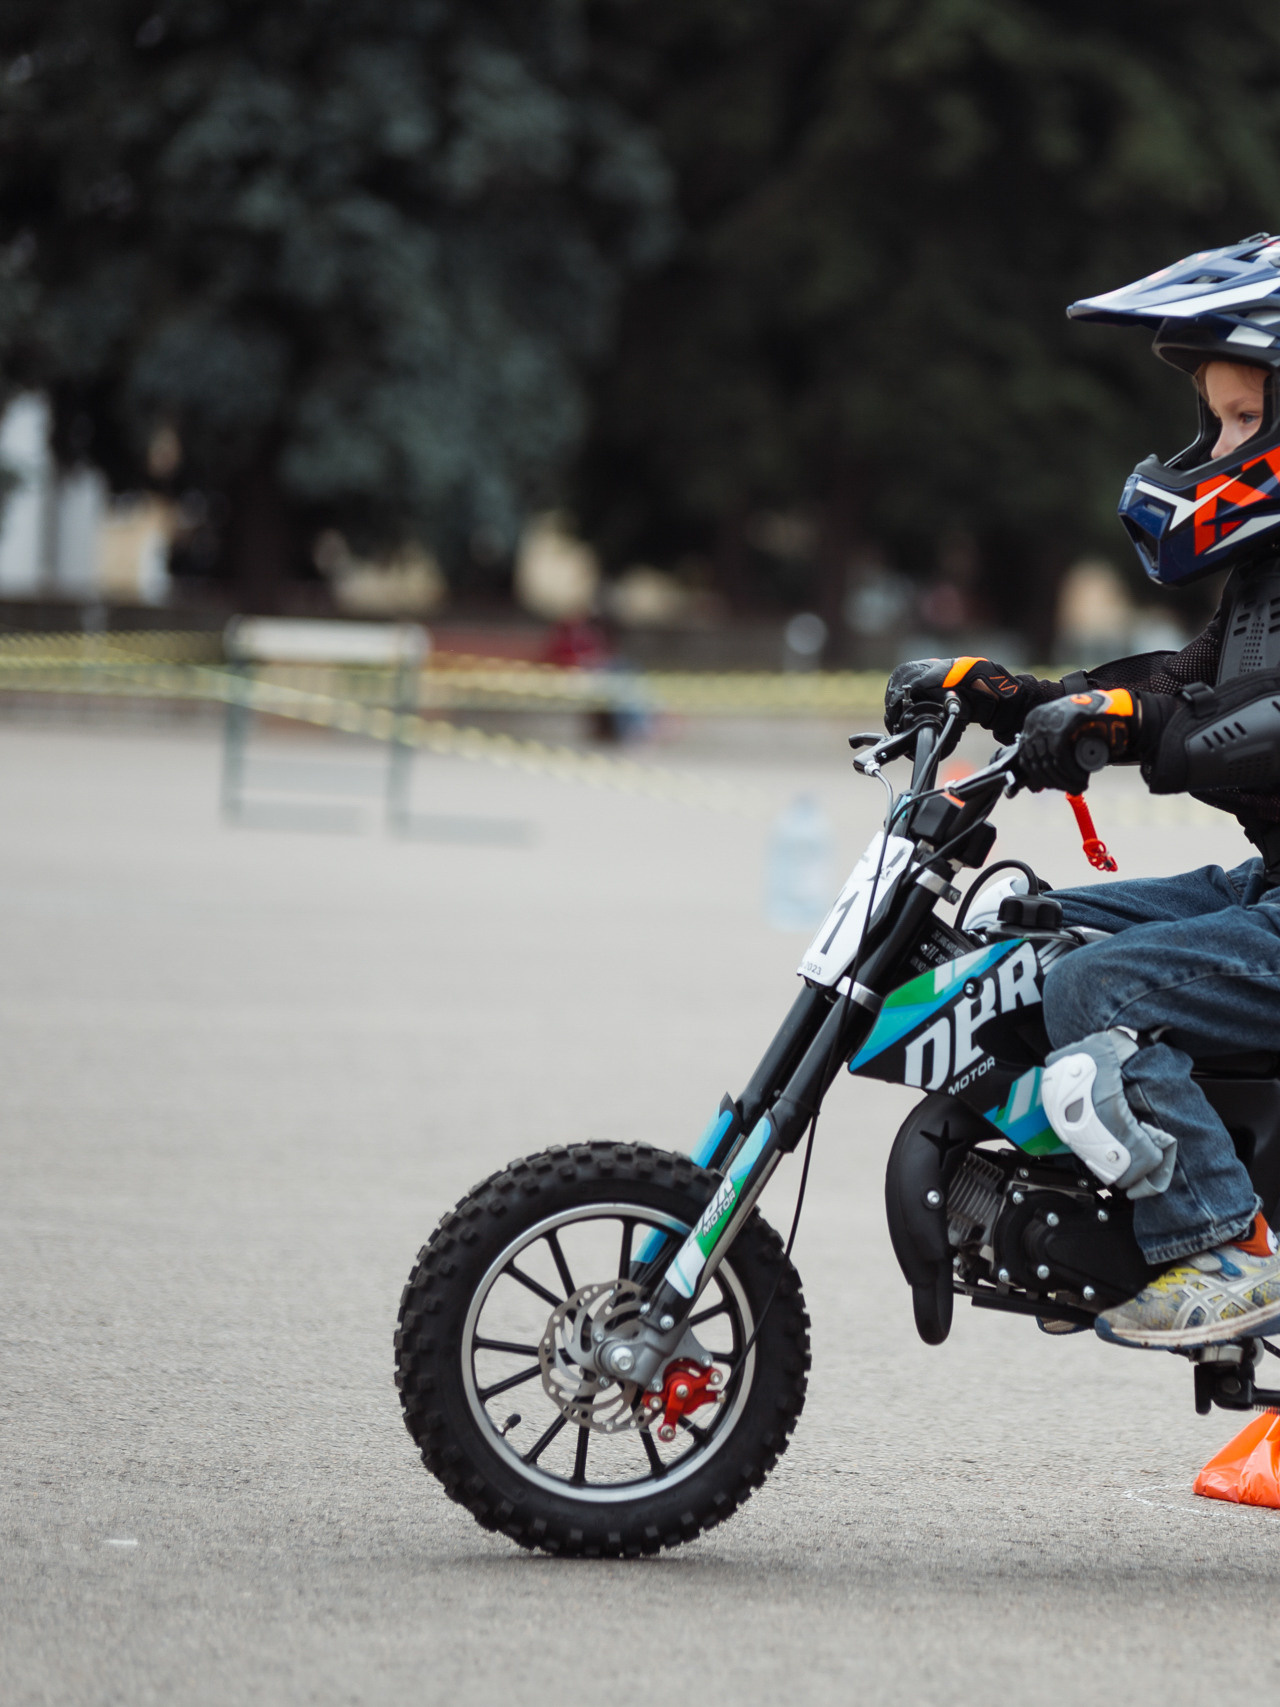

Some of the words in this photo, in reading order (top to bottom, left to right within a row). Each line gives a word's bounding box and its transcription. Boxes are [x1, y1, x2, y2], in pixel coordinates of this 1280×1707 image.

[803, 960, 822, 976] 023
[948, 1056, 996, 1096] MOTOR
[702, 1190, 736, 1236] MOTOR
